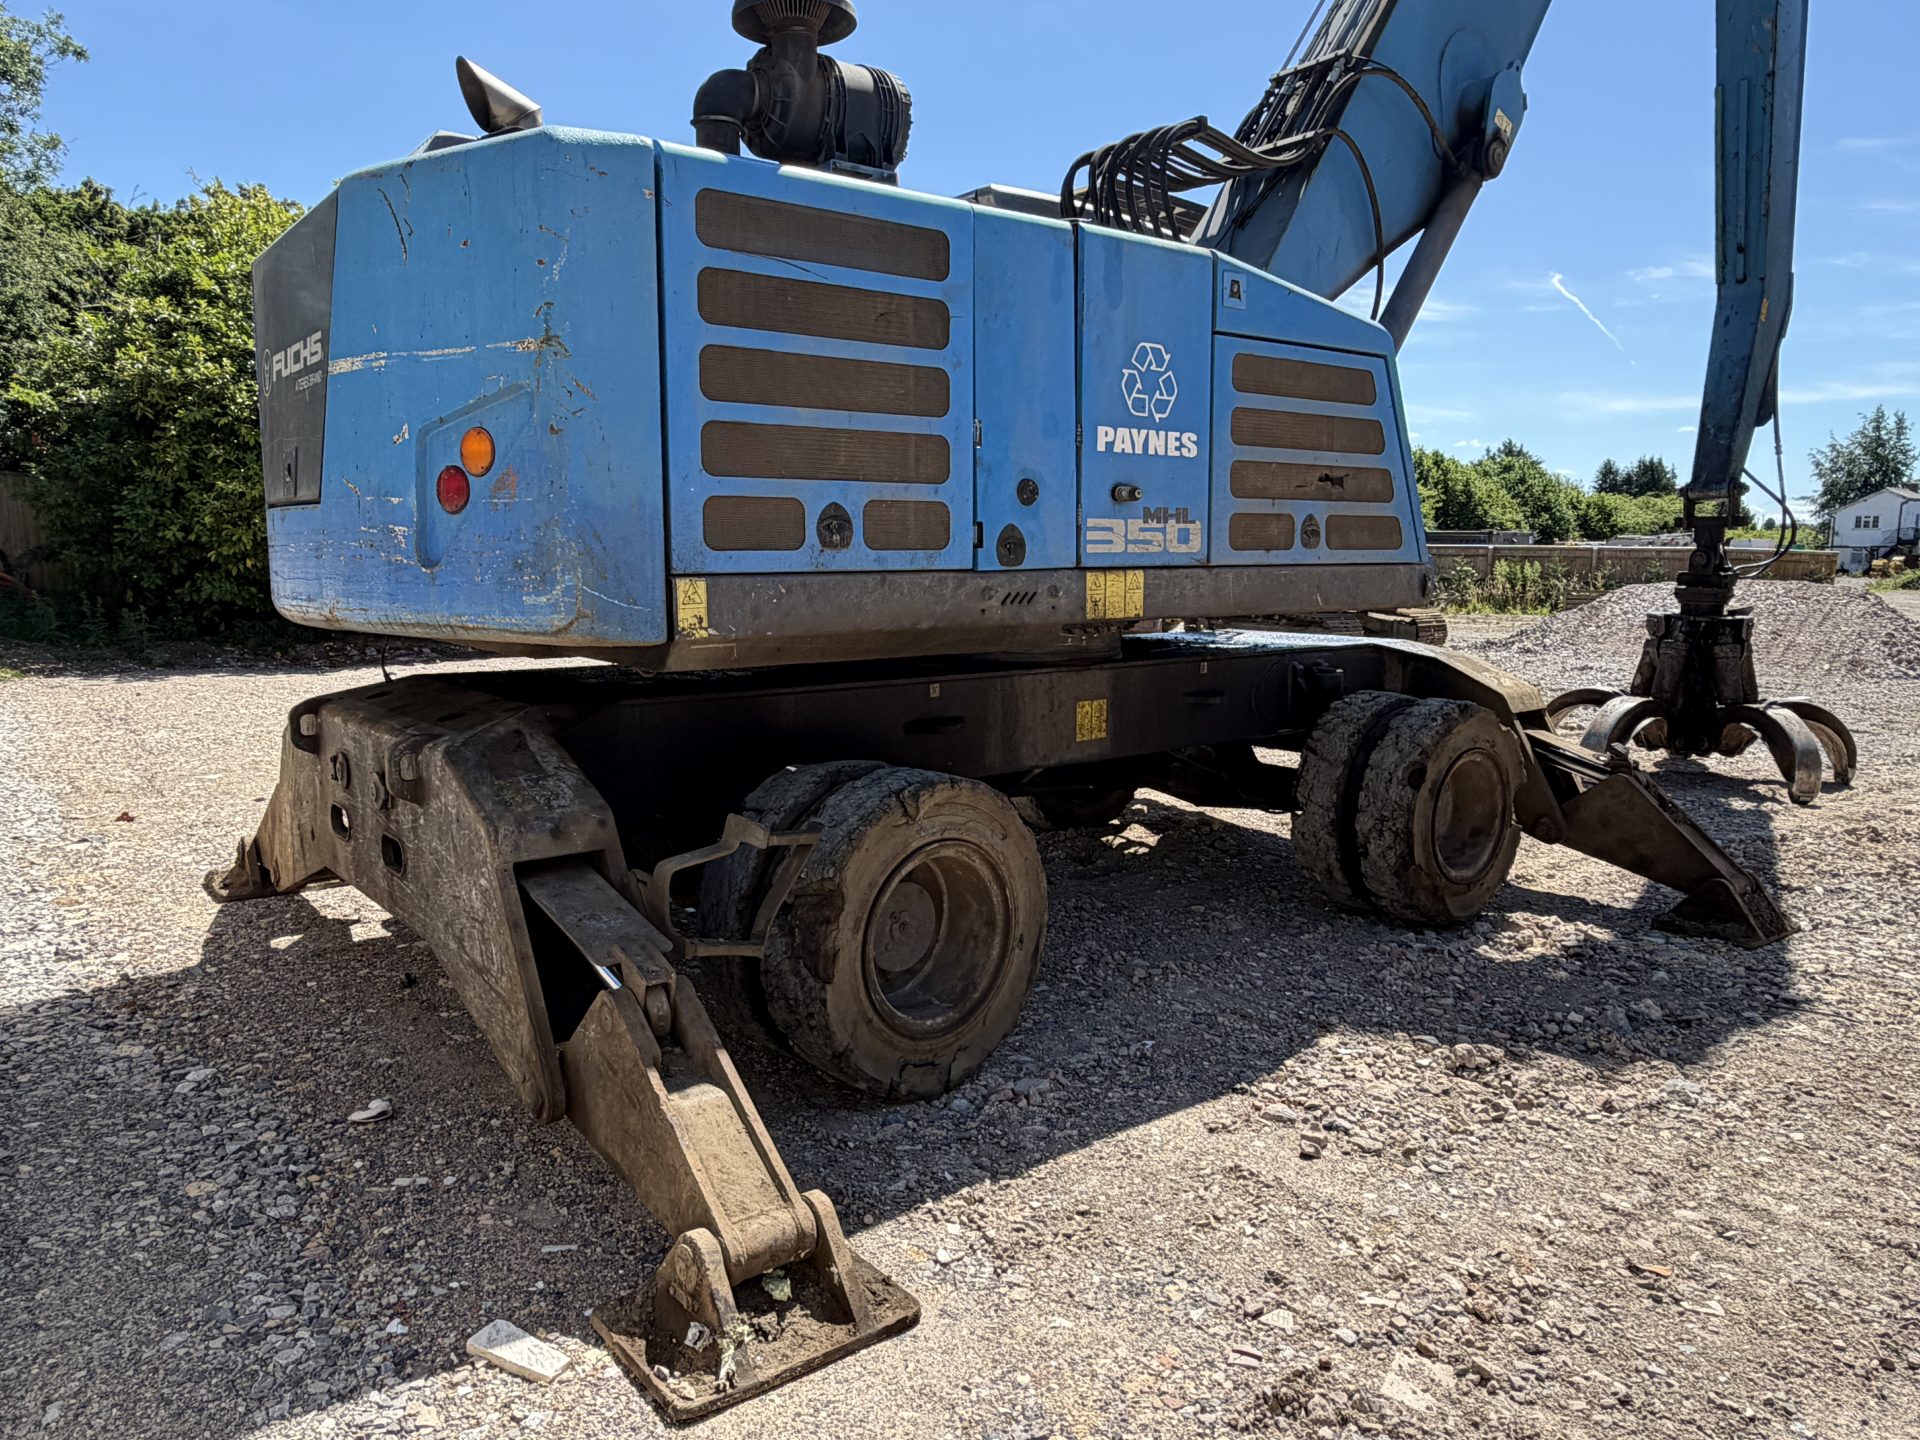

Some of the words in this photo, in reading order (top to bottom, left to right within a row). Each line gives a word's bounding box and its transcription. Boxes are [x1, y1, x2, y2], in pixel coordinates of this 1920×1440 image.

[272, 331, 322, 383] FUCHS
[1097, 426, 1198, 458] PAYNES
[1142, 506, 1197, 525] MHL
[1086, 518, 1202, 553] 350
